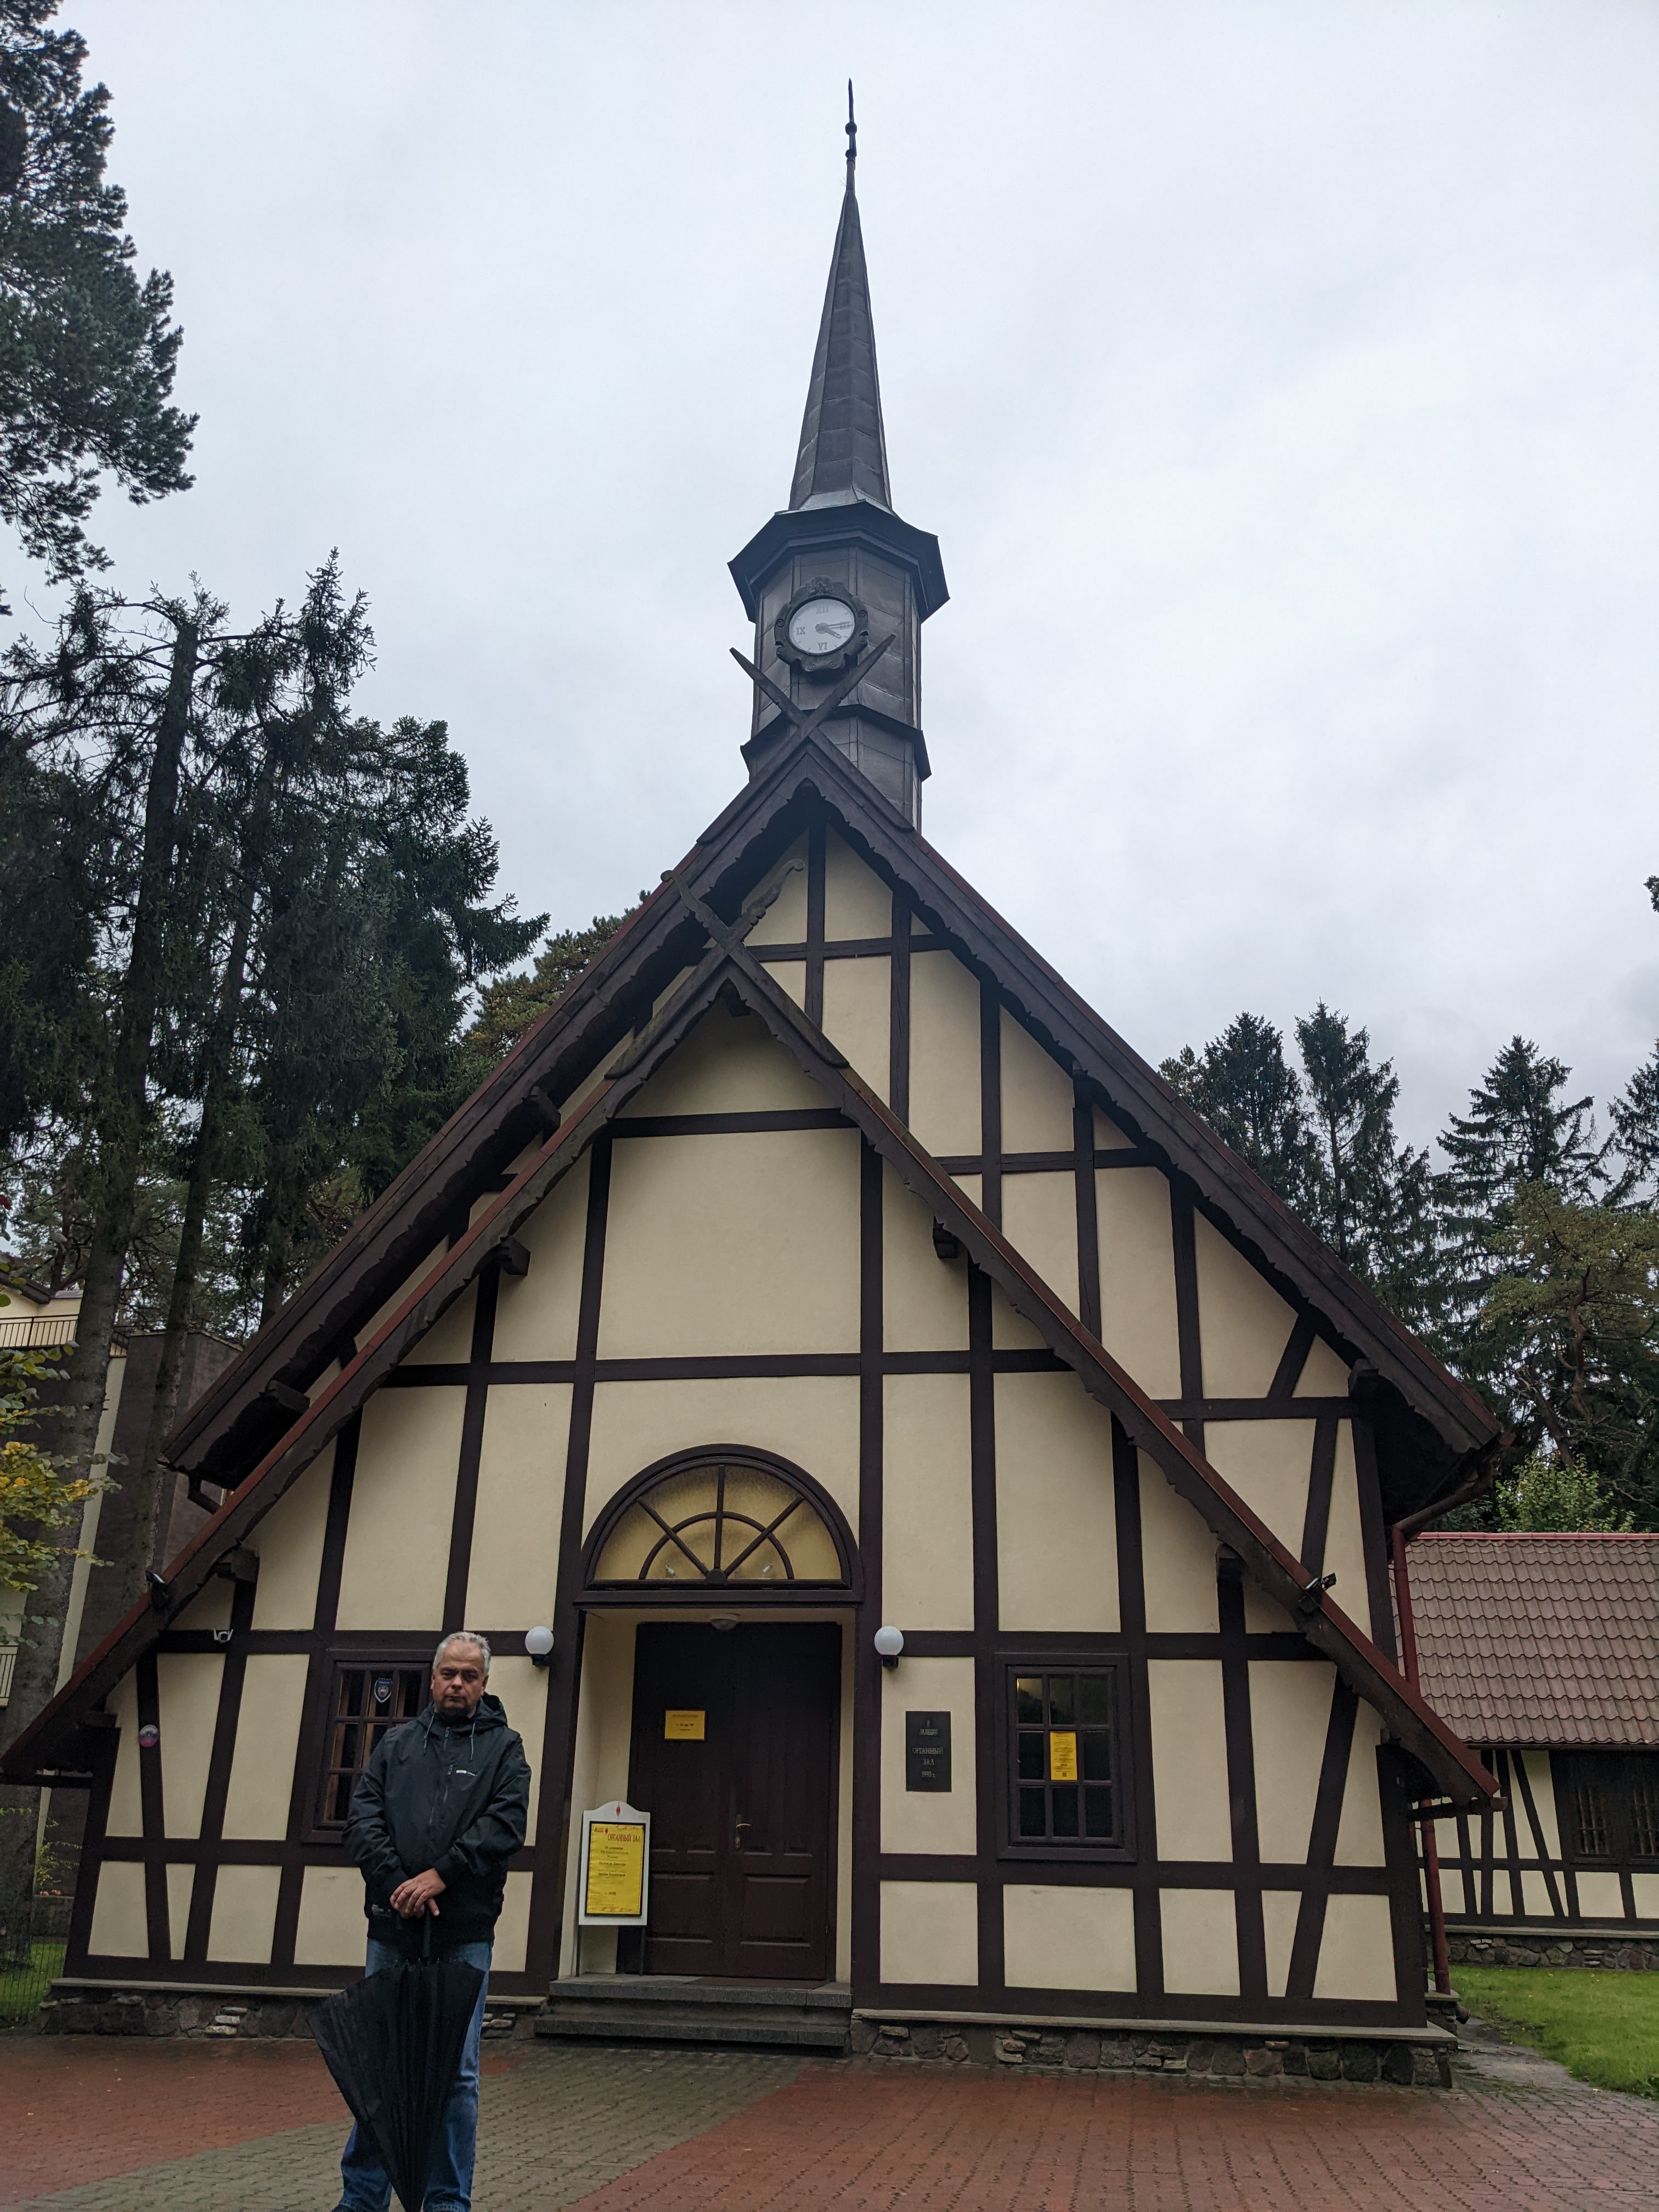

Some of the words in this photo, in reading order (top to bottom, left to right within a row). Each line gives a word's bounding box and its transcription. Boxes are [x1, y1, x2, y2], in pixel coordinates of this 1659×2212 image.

[796, 627, 806, 635] IX
[818, 642, 828, 650] VI
[608, 1833, 631, 1842] ОРГАННЫЙ
